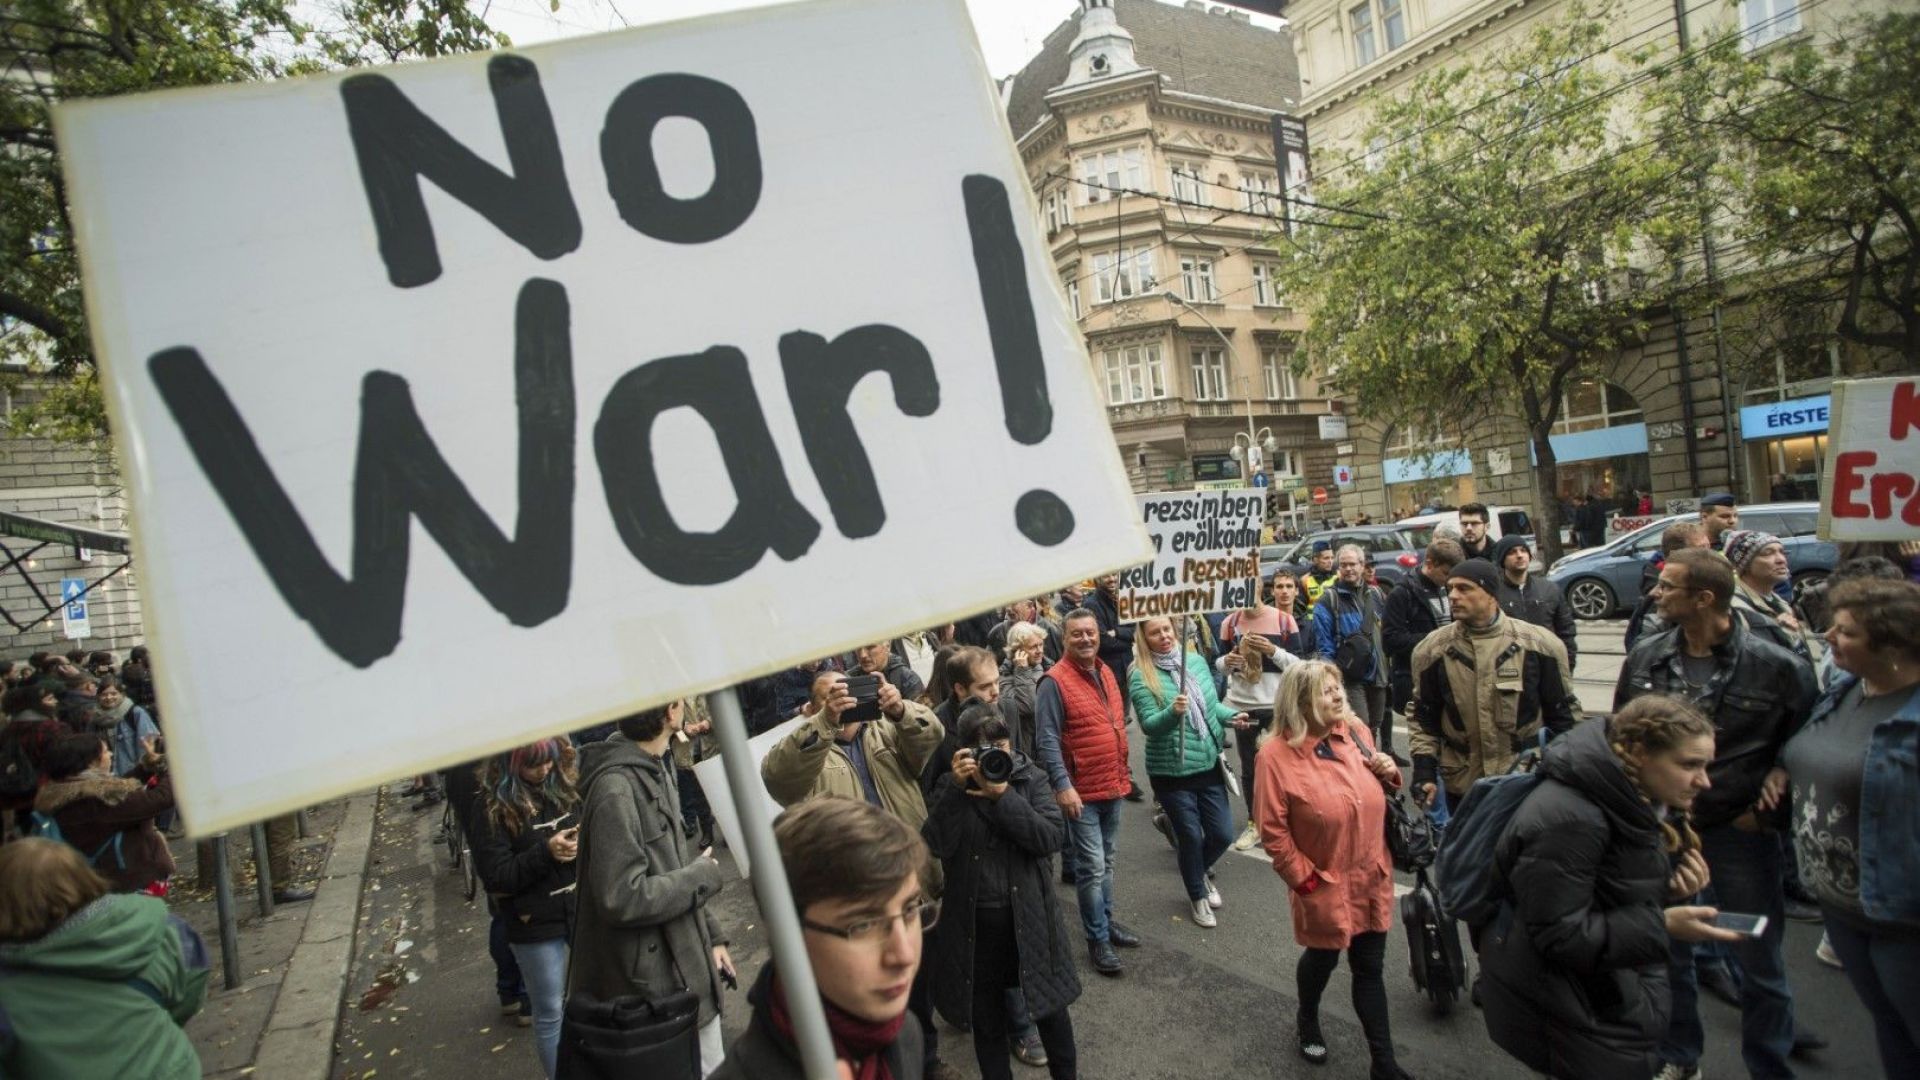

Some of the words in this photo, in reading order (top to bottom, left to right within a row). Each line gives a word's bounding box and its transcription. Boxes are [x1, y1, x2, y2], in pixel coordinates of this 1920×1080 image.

[342, 54, 763, 288] No
[147, 174, 1075, 669] War!
[1767, 407, 1829, 428] ERSTE
[1144, 490, 1262, 523] rezsimben
[1119, 561, 1160, 590] kell,
[1163, 566, 1176, 586] a
[1182, 549, 1259, 583] rezsimet
[1119, 581, 1215, 619] elzavarni
[1221, 577, 1256, 609] kell
